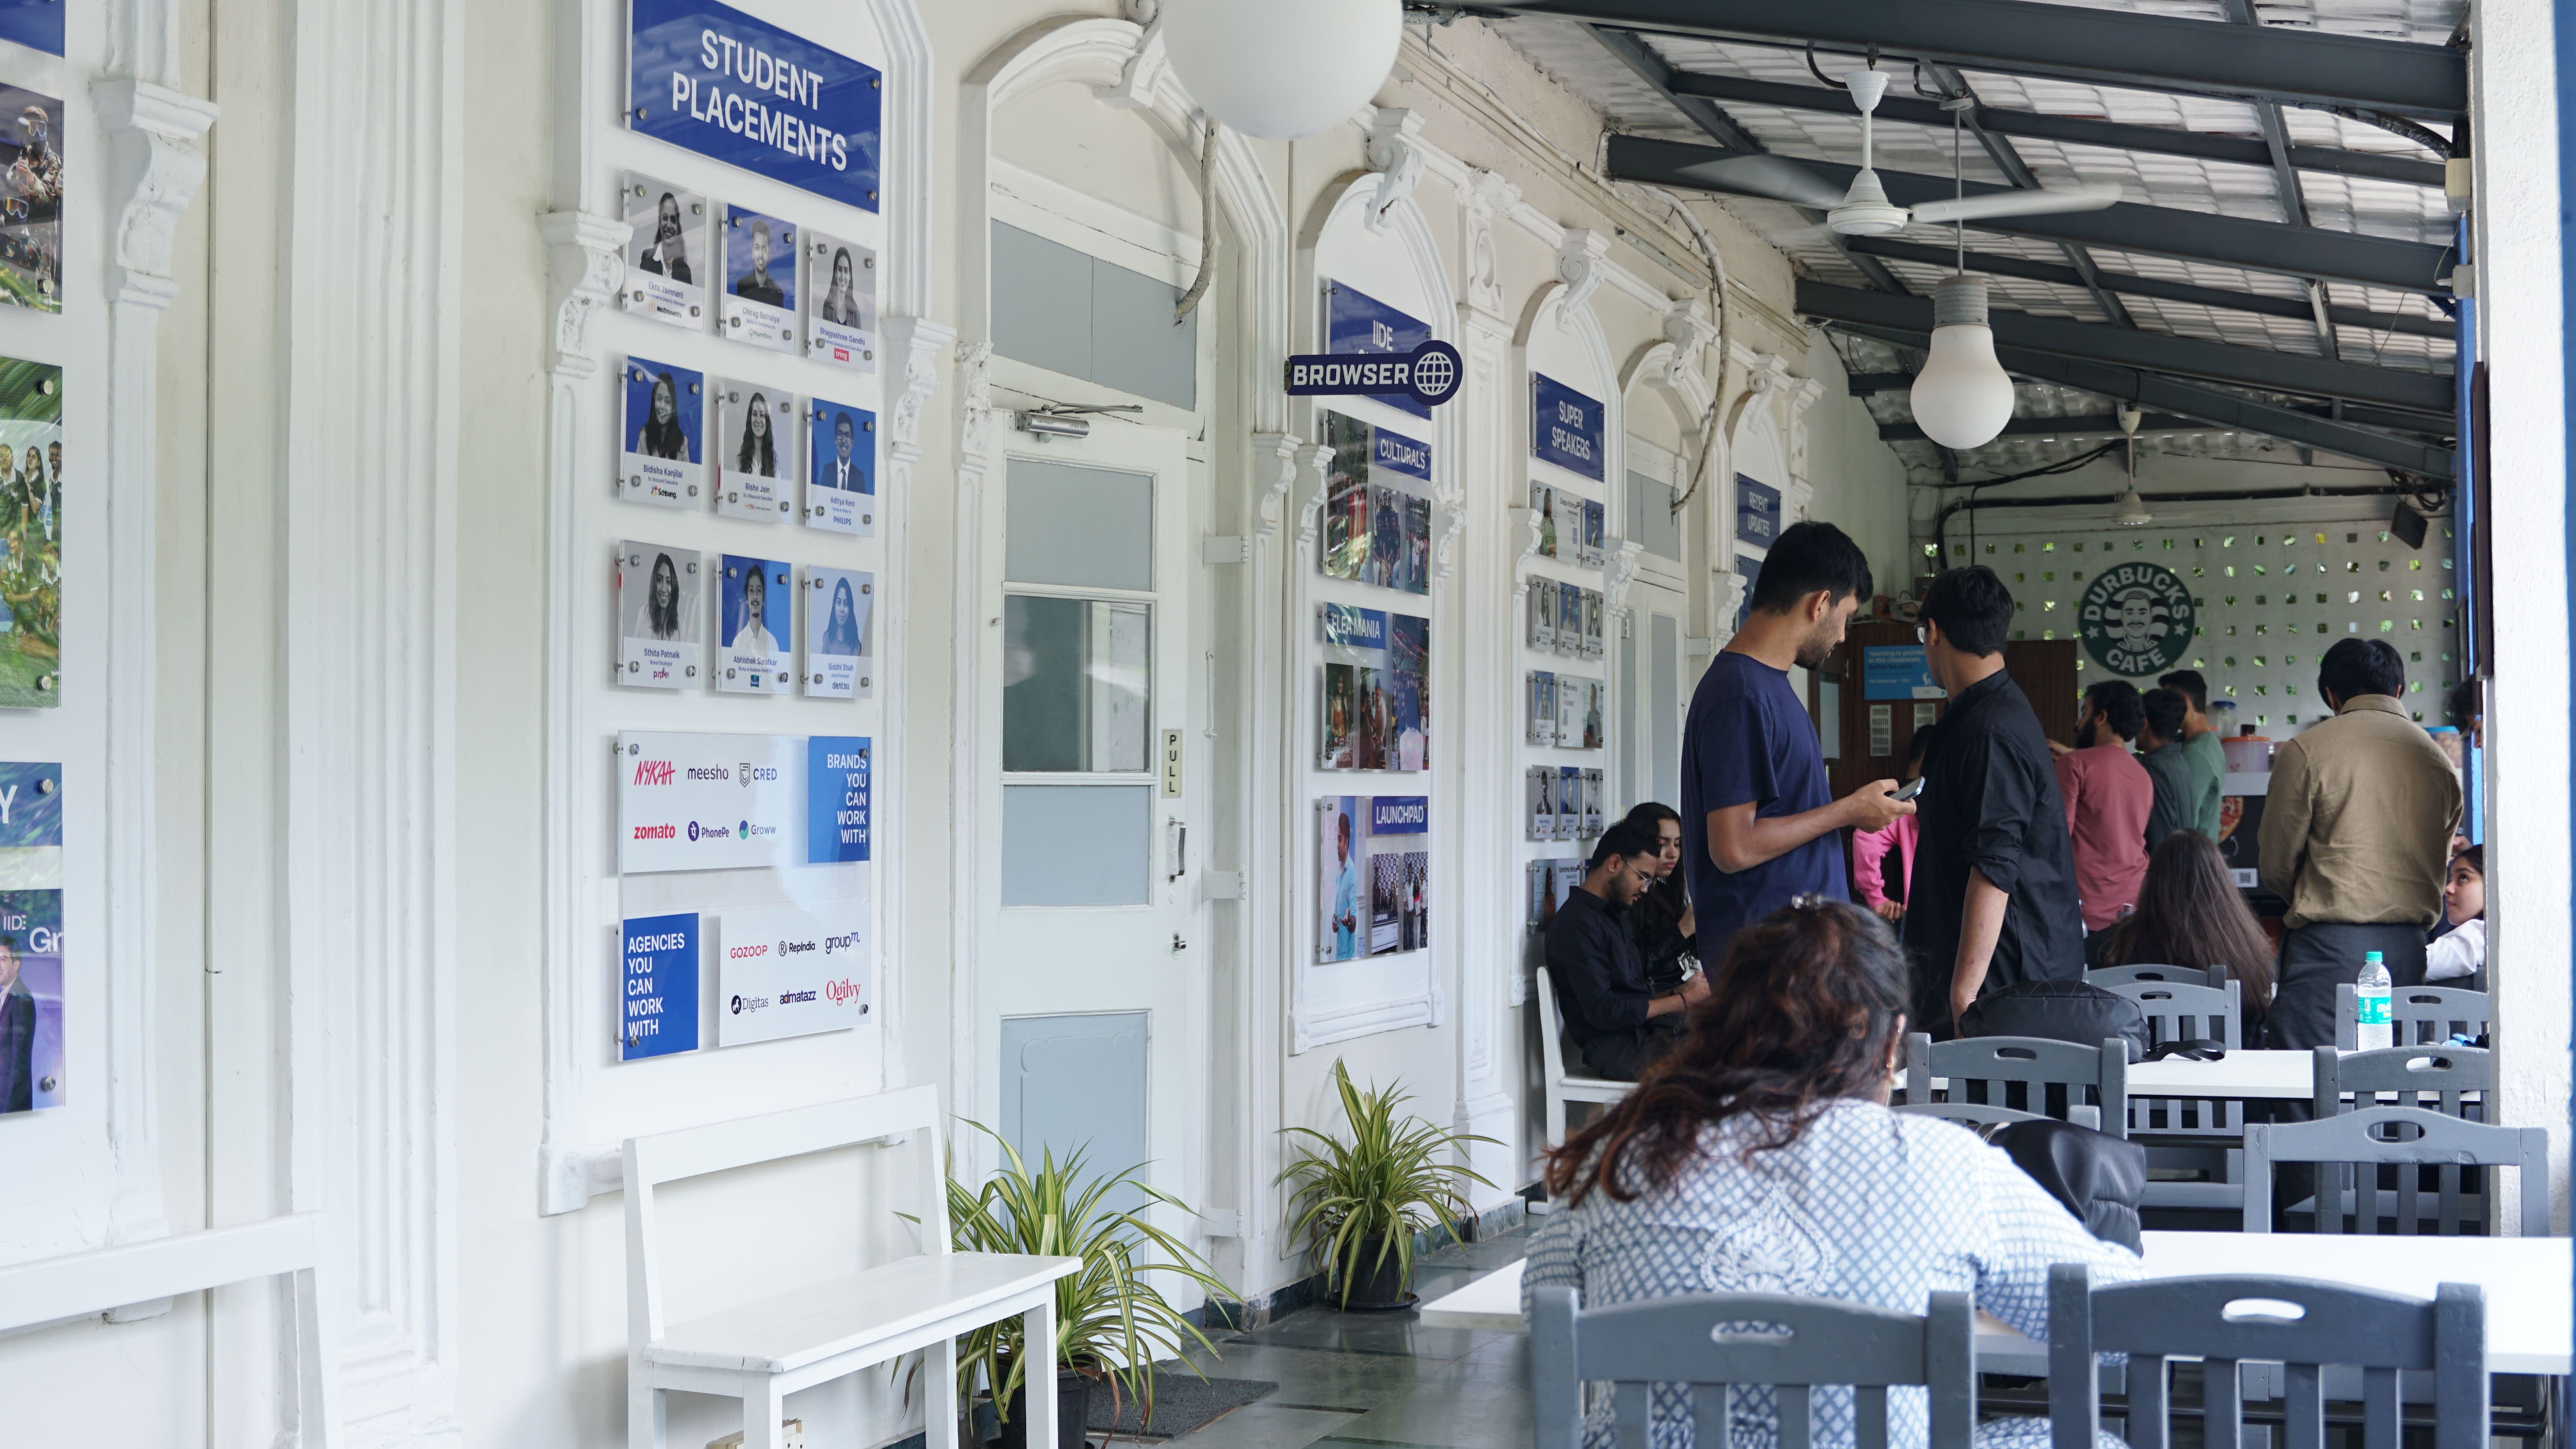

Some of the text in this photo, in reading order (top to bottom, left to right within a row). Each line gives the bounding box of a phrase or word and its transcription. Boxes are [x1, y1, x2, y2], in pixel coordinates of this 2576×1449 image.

[702, 30, 823, 110] STUDENT
[673, 71, 847, 171] PLACEMENTS
[649, 282, 683, 299] Ekta Jamnani
[743, 307, 780, 324] Chirag Somaiya
[753, 330, 772, 341] PharmEasy
[820, 327, 865, 346] Bhagyashree Gandhi
[1373, 320, 1393, 352] IIDE
[835, 351, 847, 361] tring
[1293, 364, 1409, 386] BROWSER
[1559, 400, 1583, 430] SUPER
[1552, 426, 1590, 461] SPEAKERS
[1380, 439, 1425, 470] CULTURALS
[644, 465, 683, 479] Bidisha Kanjilal
[759, 484, 770, 494] Jain
[830, 496, 855, 507] Aditya Keni
[1749, 491, 1768, 515] RECENT
[833, 516, 851, 525] PHILIPS
[1748, 514, 1769, 537] UPDATES
[2084, 566, 2189, 621] DURBUCKS
[1332, 614, 1380, 639] FLEA MANIA
[644, 648, 680, 659] Sthita Patnaik
[734, 656, 778, 666] Abhishek Suratkar
[2106, 648, 2166, 673] CAFE
[832, 682, 850, 690] dentsu
[827, 754, 867, 769] BRANDS
[1169, 735, 1177, 793] PULL
[634, 760, 778, 785] NYKAA meesho CRED
[846, 773, 866, 788] YOU
[846, 791, 866, 806] CAN
[837, 810, 866, 825] WORK
[1376, 806, 1424, 825] LAUNCHPAD
[634, 822, 675, 840] zomato
[702, 825, 776, 839] PhonePe Groww
[841, 829, 866, 844] WITH
[3, 915, 26, 931] IIDE
[628, 933, 685, 954] AGENCIES
[731, 945, 768, 958] GOZOOP
[789, 942, 815, 954] RepIndia
[628, 957, 652, 974] YOU
[628, 977, 653, 996] CAN
[826, 978, 861, 1006] Ogilvy
[742, 996, 769, 1015] Digitas
[780, 990, 816, 1005] admatazz
[628, 997, 663, 1017] WORK
[628, 1019, 659, 1037] WITH
